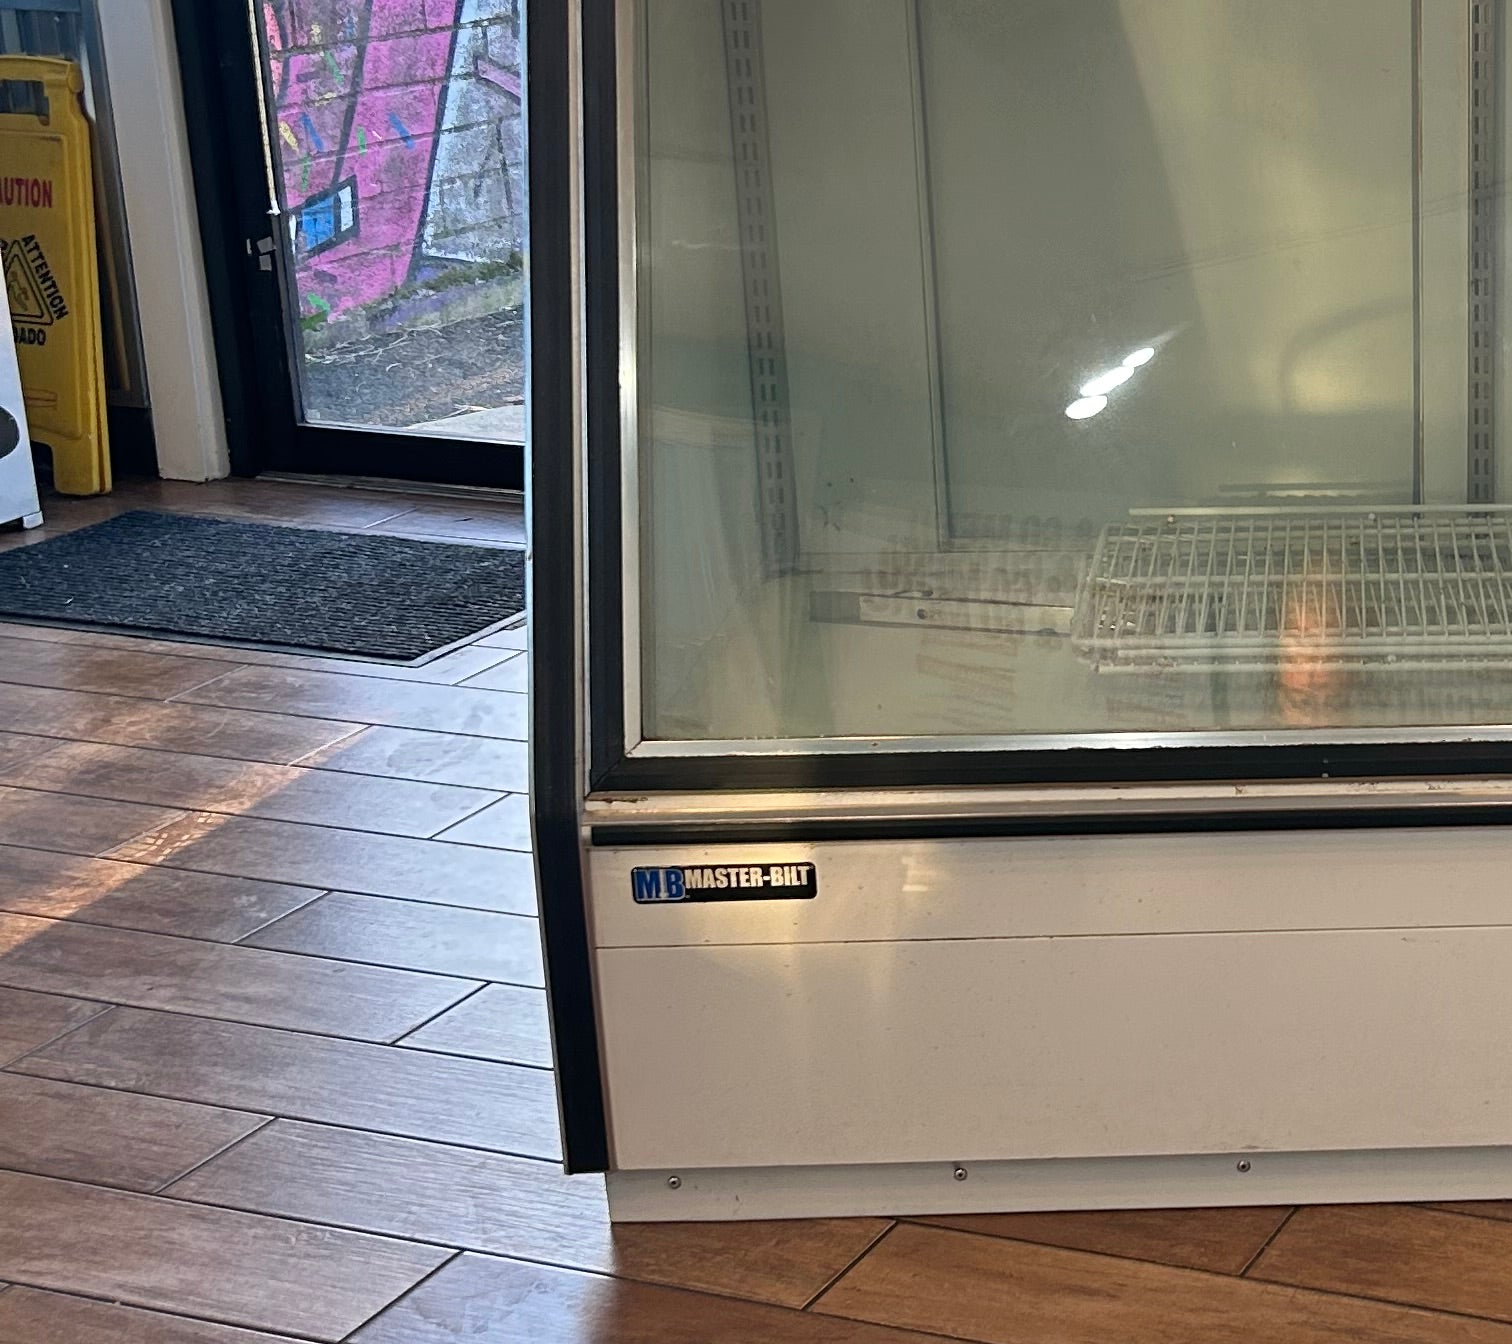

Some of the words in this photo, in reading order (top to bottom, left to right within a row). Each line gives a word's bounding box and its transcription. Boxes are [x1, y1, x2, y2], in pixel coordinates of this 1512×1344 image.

[21, 234, 70, 321] ATTENTION
[633, 868, 686, 902] MB
[684, 865, 811, 890] MASTER-BILT
